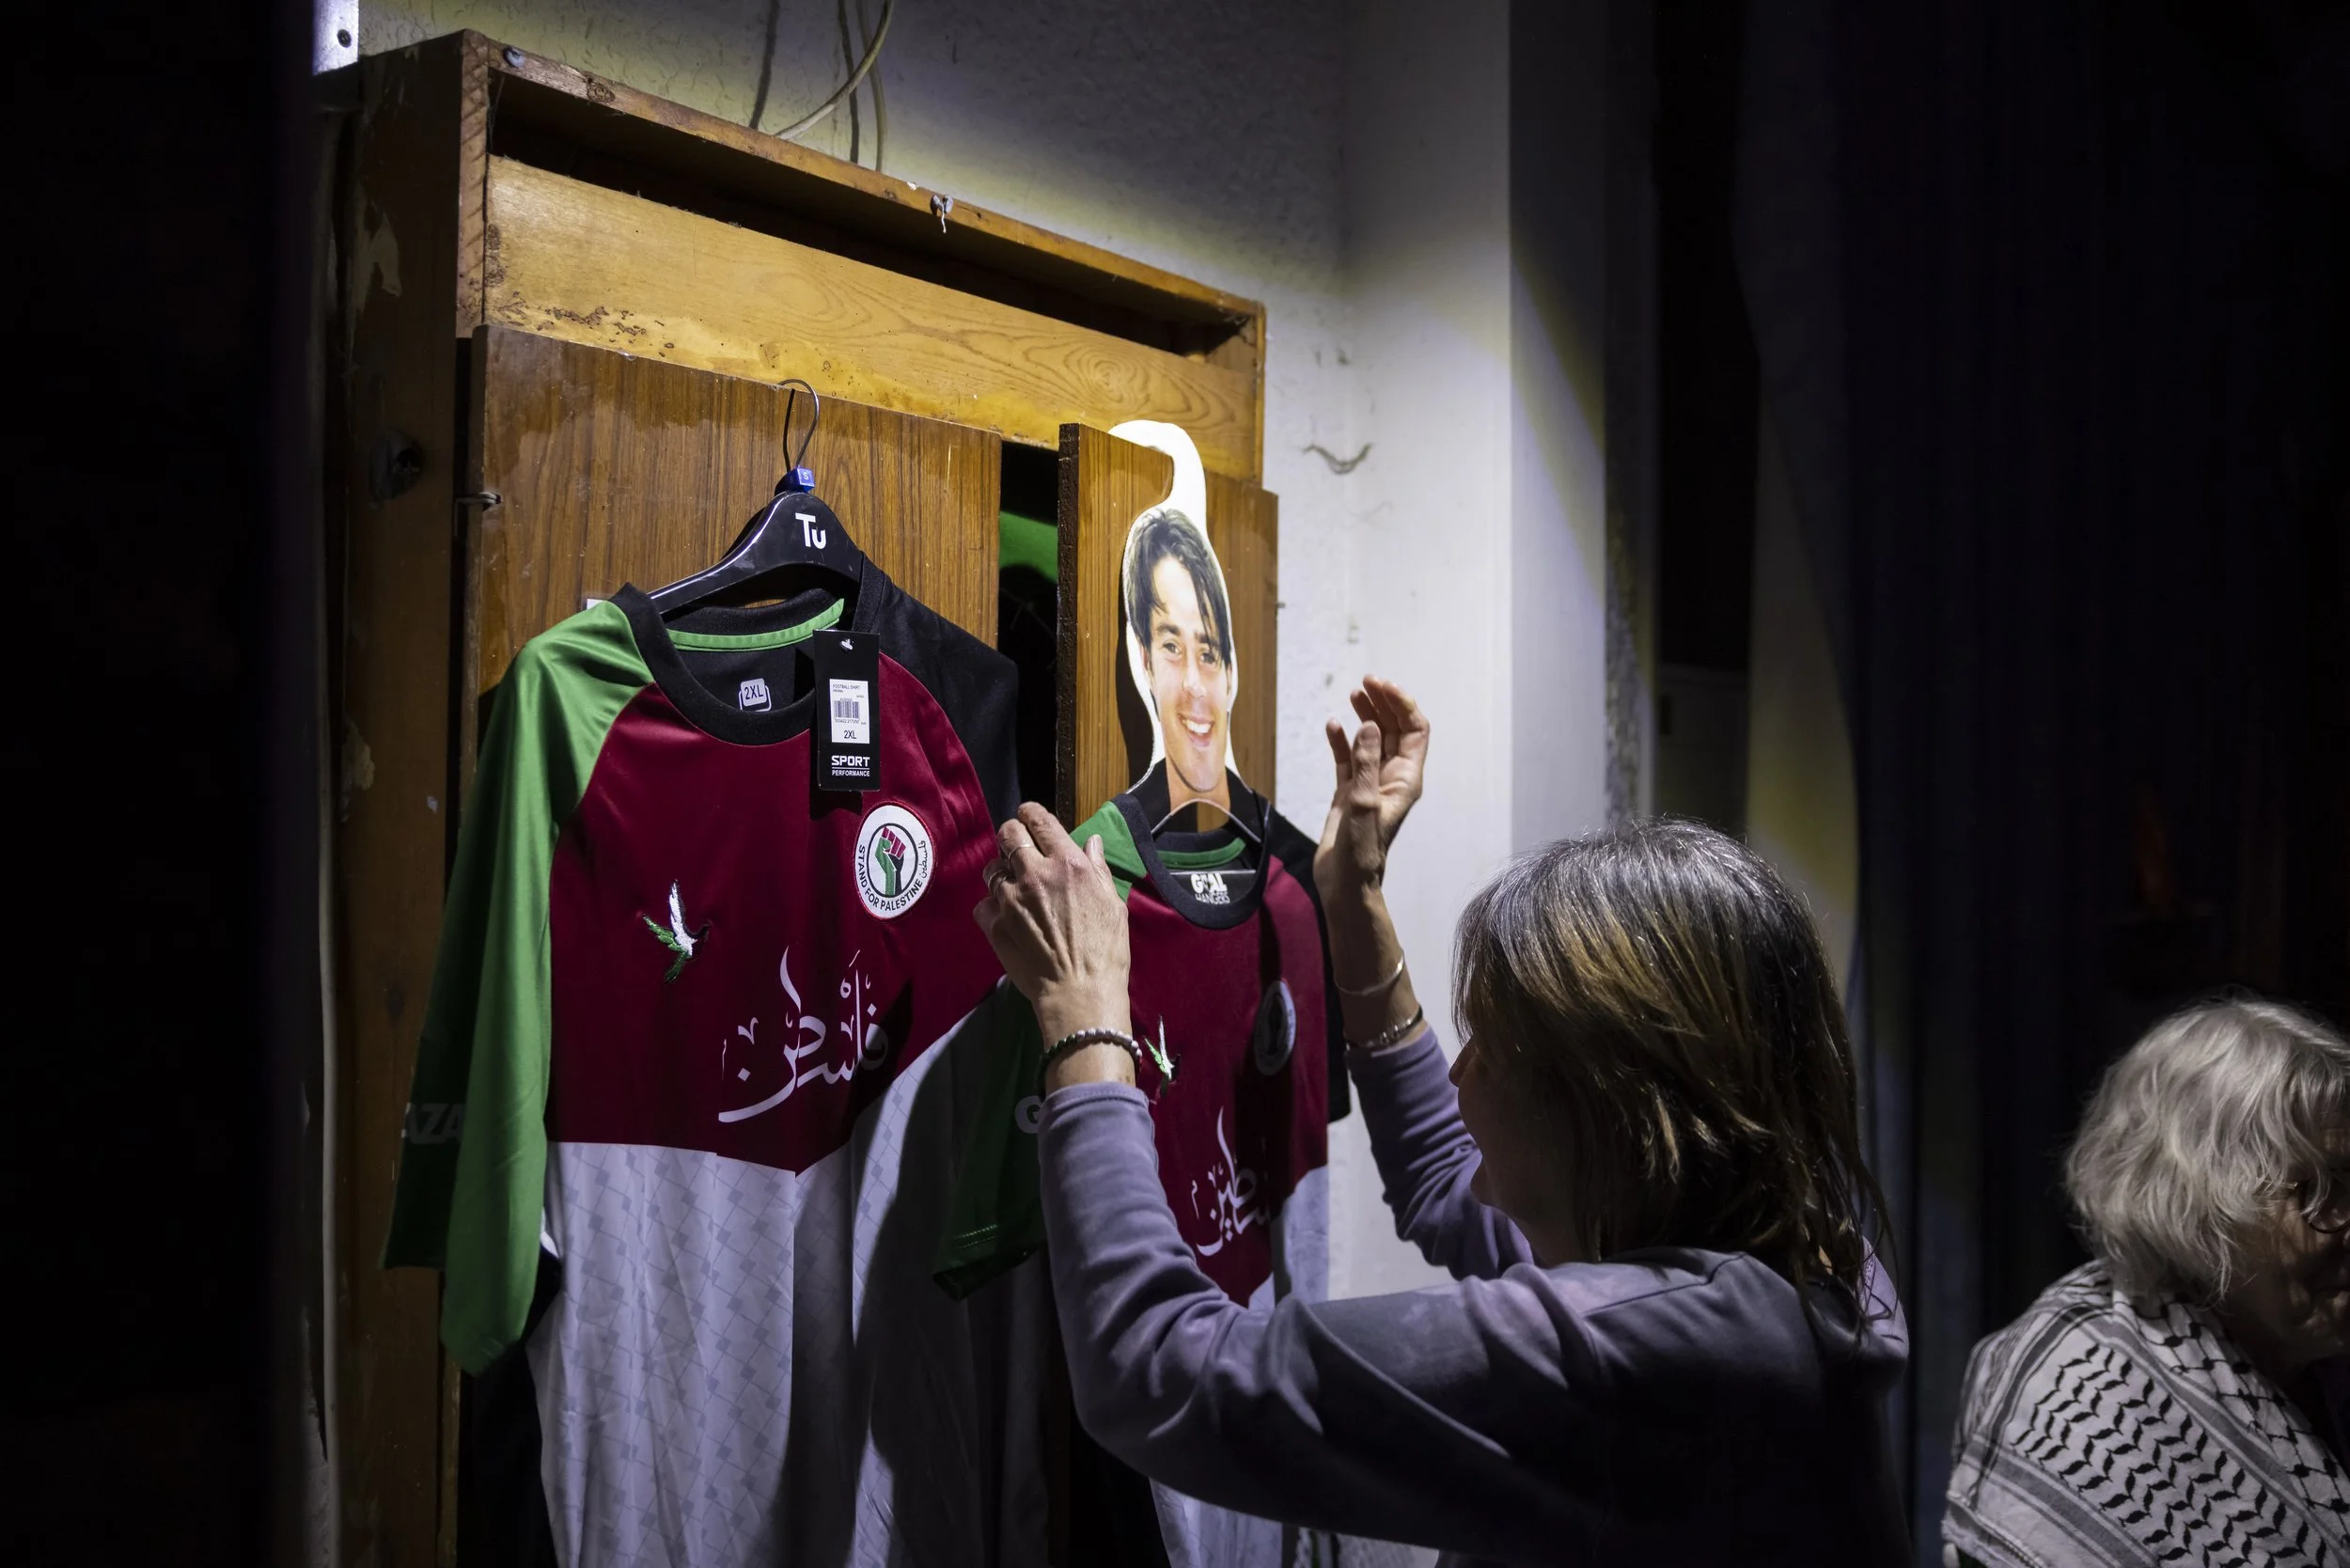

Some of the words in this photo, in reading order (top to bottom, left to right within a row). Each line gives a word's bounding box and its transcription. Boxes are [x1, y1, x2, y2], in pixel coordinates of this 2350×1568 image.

[795, 512, 827, 550] Tu
[744, 684, 764, 700] 2XL
[844, 730, 856, 739] 2XL
[831, 756, 870, 766] SPORT
[858, 844, 868, 888] STAND
[864, 888, 881, 908] FOR
[880, 878, 923, 912] PALESTINE
